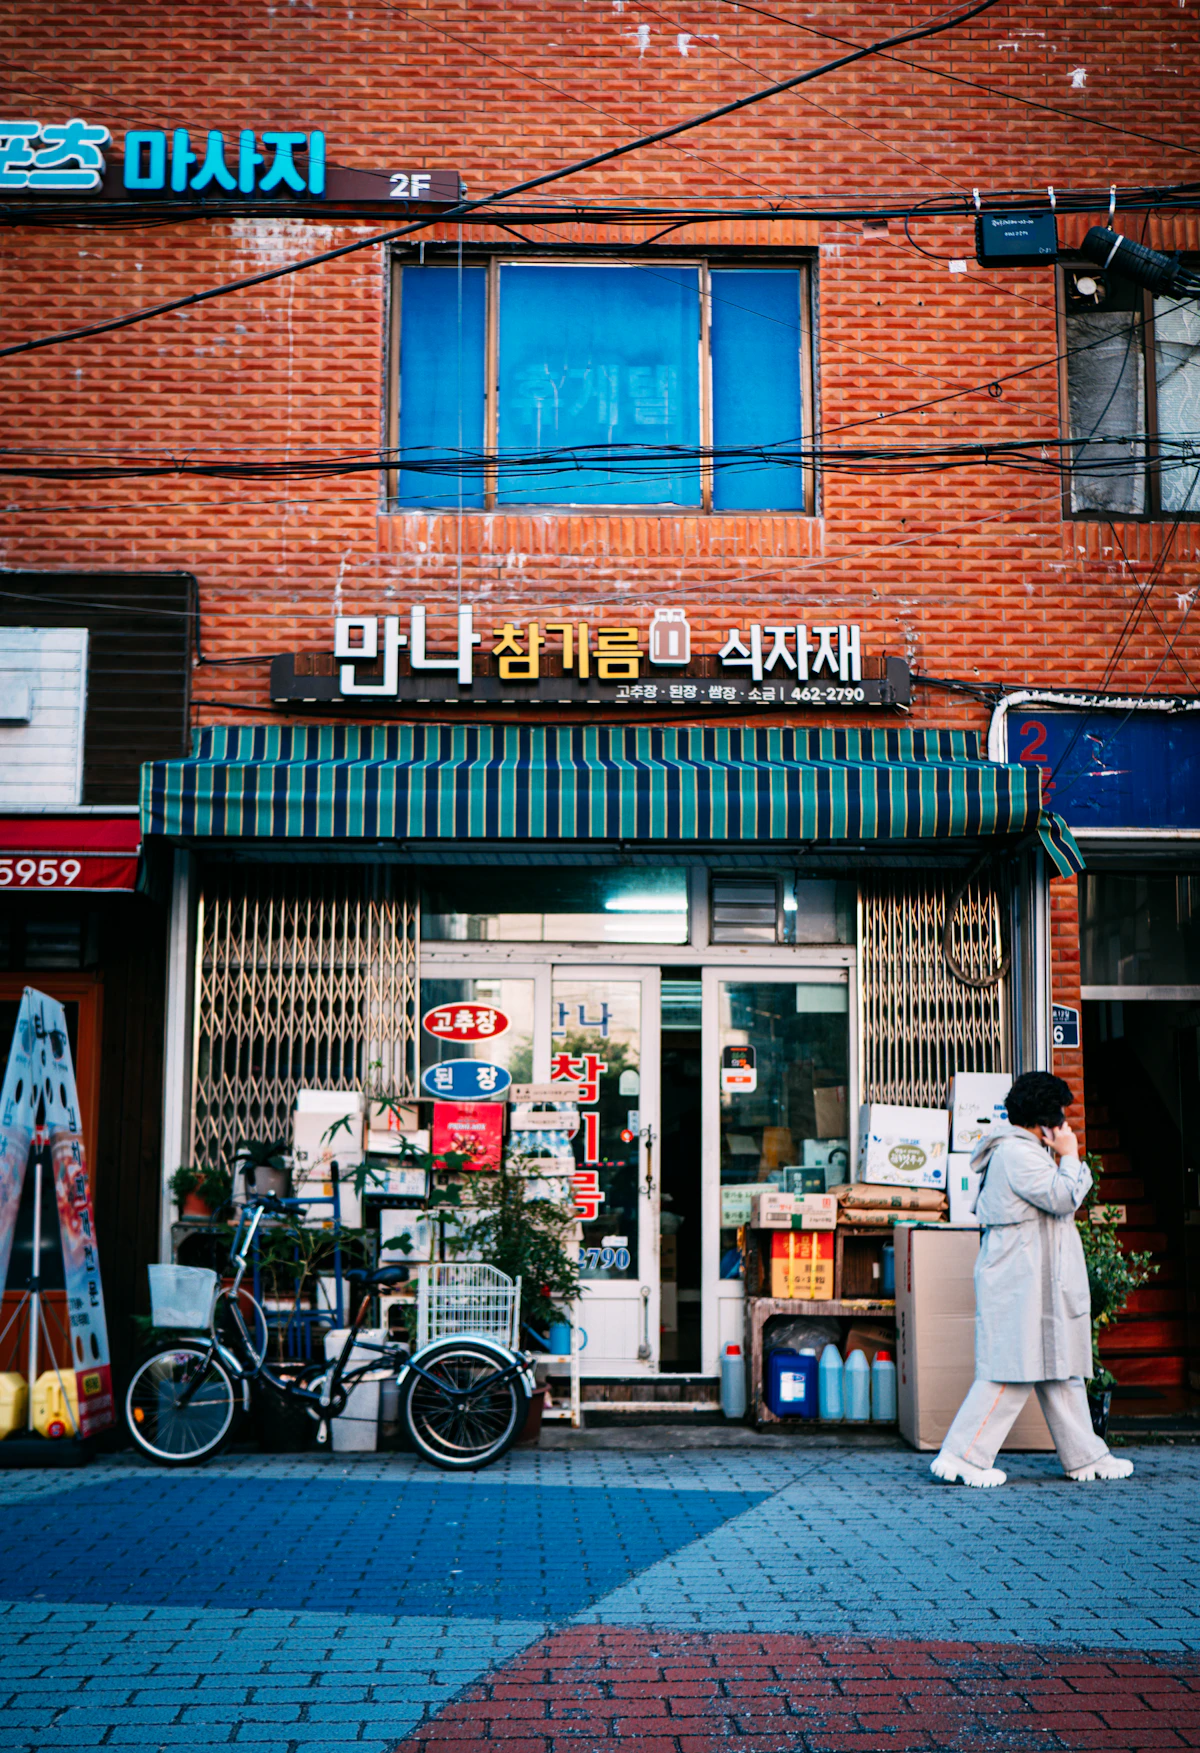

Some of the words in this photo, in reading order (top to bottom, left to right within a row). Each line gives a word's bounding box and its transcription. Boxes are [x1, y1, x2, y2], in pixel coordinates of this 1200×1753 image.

[124, 128, 326, 196] 마사지
[389, 172, 432, 198] 2F
[334, 604, 482, 697] 만나
[492, 621, 644, 680] 참기름
[718, 624, 862, 682] 식자재
[615, 684, 659, 699] 고추장
[669, 685, 698, 699] 된장
[748, 687, 776, 701] 소금
[790, 686, 865, 702] 462-2790
[0, 858, 82, 886] 5959
[431, 1009, 498, 1035] 고추장
